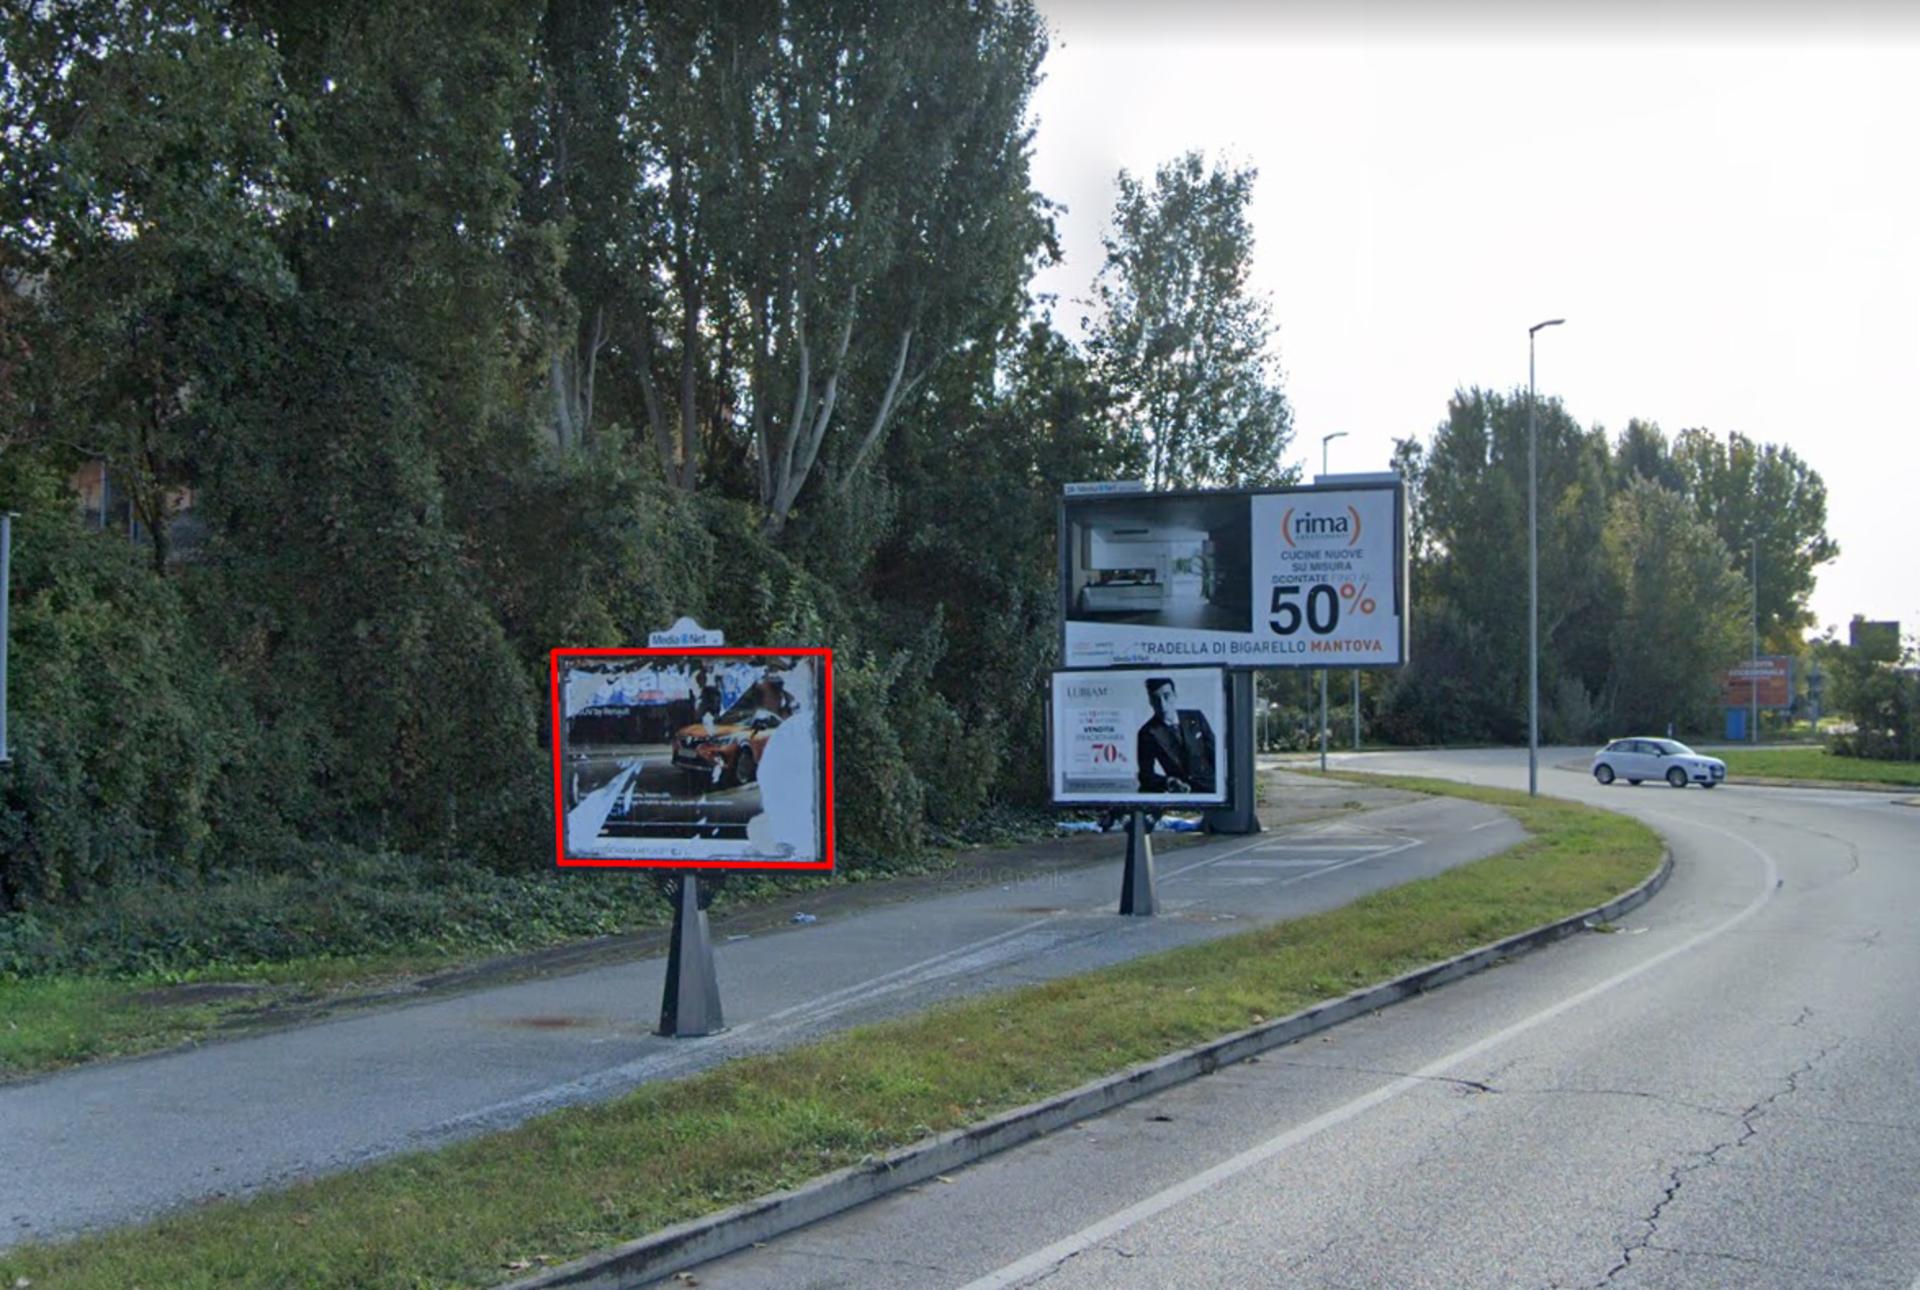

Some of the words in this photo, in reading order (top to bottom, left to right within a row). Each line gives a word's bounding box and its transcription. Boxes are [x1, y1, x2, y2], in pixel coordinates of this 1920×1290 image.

[1281, 550, 1321, 560] CUCINE
[1324, 549, 1364, 559] NUOVE
[1292, 562, 1307, 571] SU
[1309, 561, 1352, 571] MISURA
[1271, 574, 1328, 584] SCONTATE
[1268, 582, 1376, 636] 50%
[651, 634, 680, 645] Media
[689, 633, 707, 645] Net
[1135, 641, 1208, 654] TRADELLA
[1212, 641, 1226, 654] DI
[1230, 641, 1306, 653] BIGARELLO
[1311, 640, 1383, 653] MANTOVA
